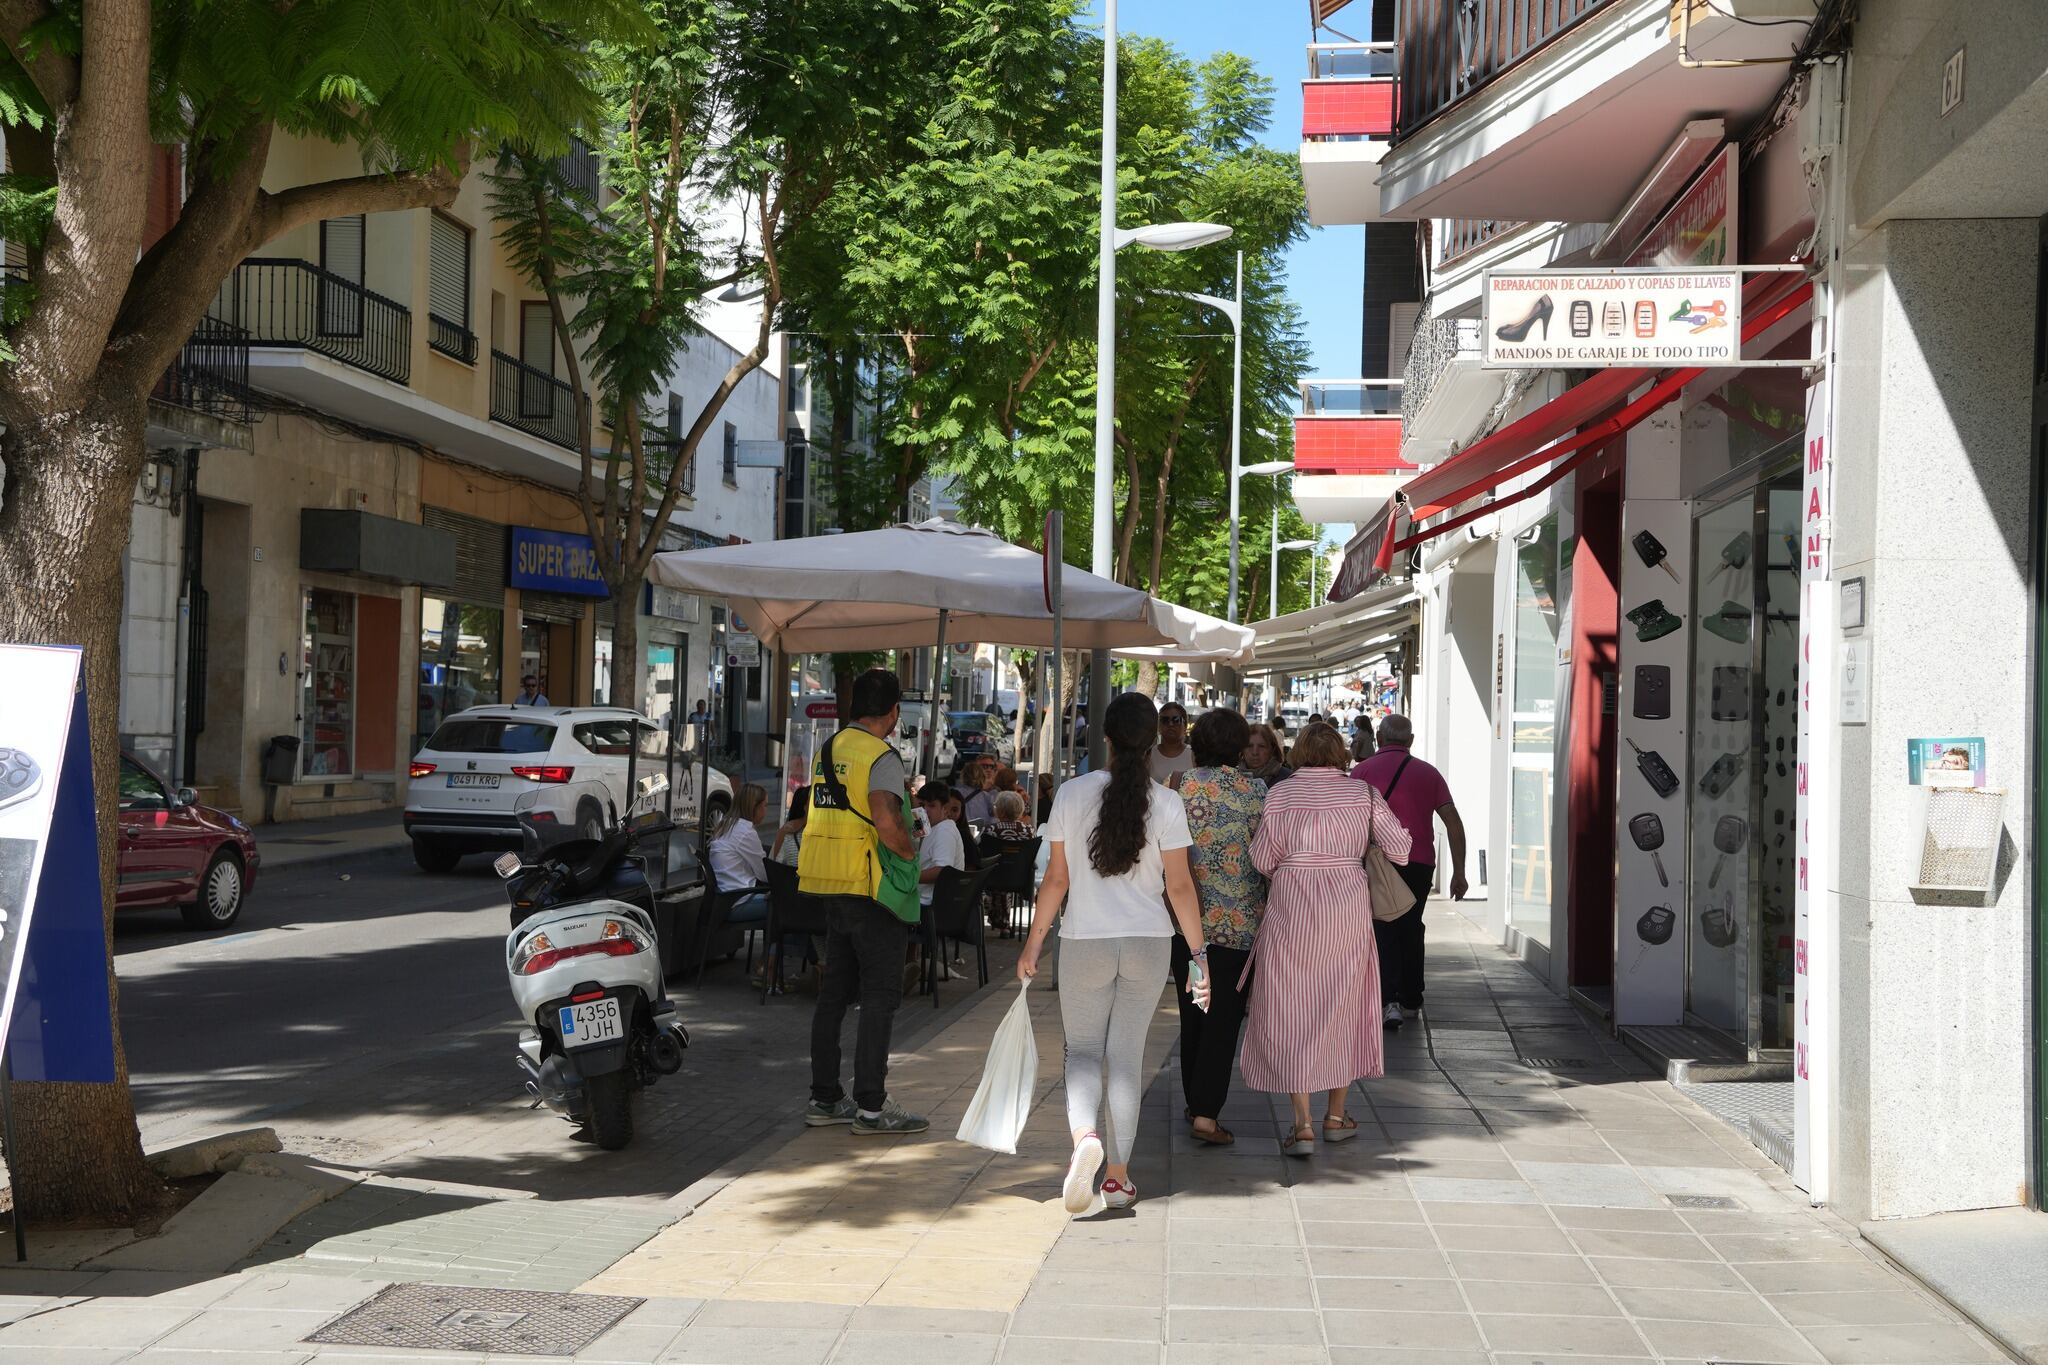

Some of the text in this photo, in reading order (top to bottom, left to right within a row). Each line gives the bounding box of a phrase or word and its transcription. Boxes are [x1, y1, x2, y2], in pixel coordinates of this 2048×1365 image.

[1945, 57, 1960, 107] 61
[1688, 167, 1726, 242] CALZADO
[1493, 276, 1731, 291] REPARACION DE CALZADO Y COPIAS DE LLAVES
[1494, 345, 1729, 361] MANDOS DE GARAJE DE TODO TIPO
[518, 541, 564, 577] SUPER
[453, 775, 498, 785] 0491 KRG
[576, 1001, 617, 1024] 4356
[581, 1019, 614, 1041] JJH
